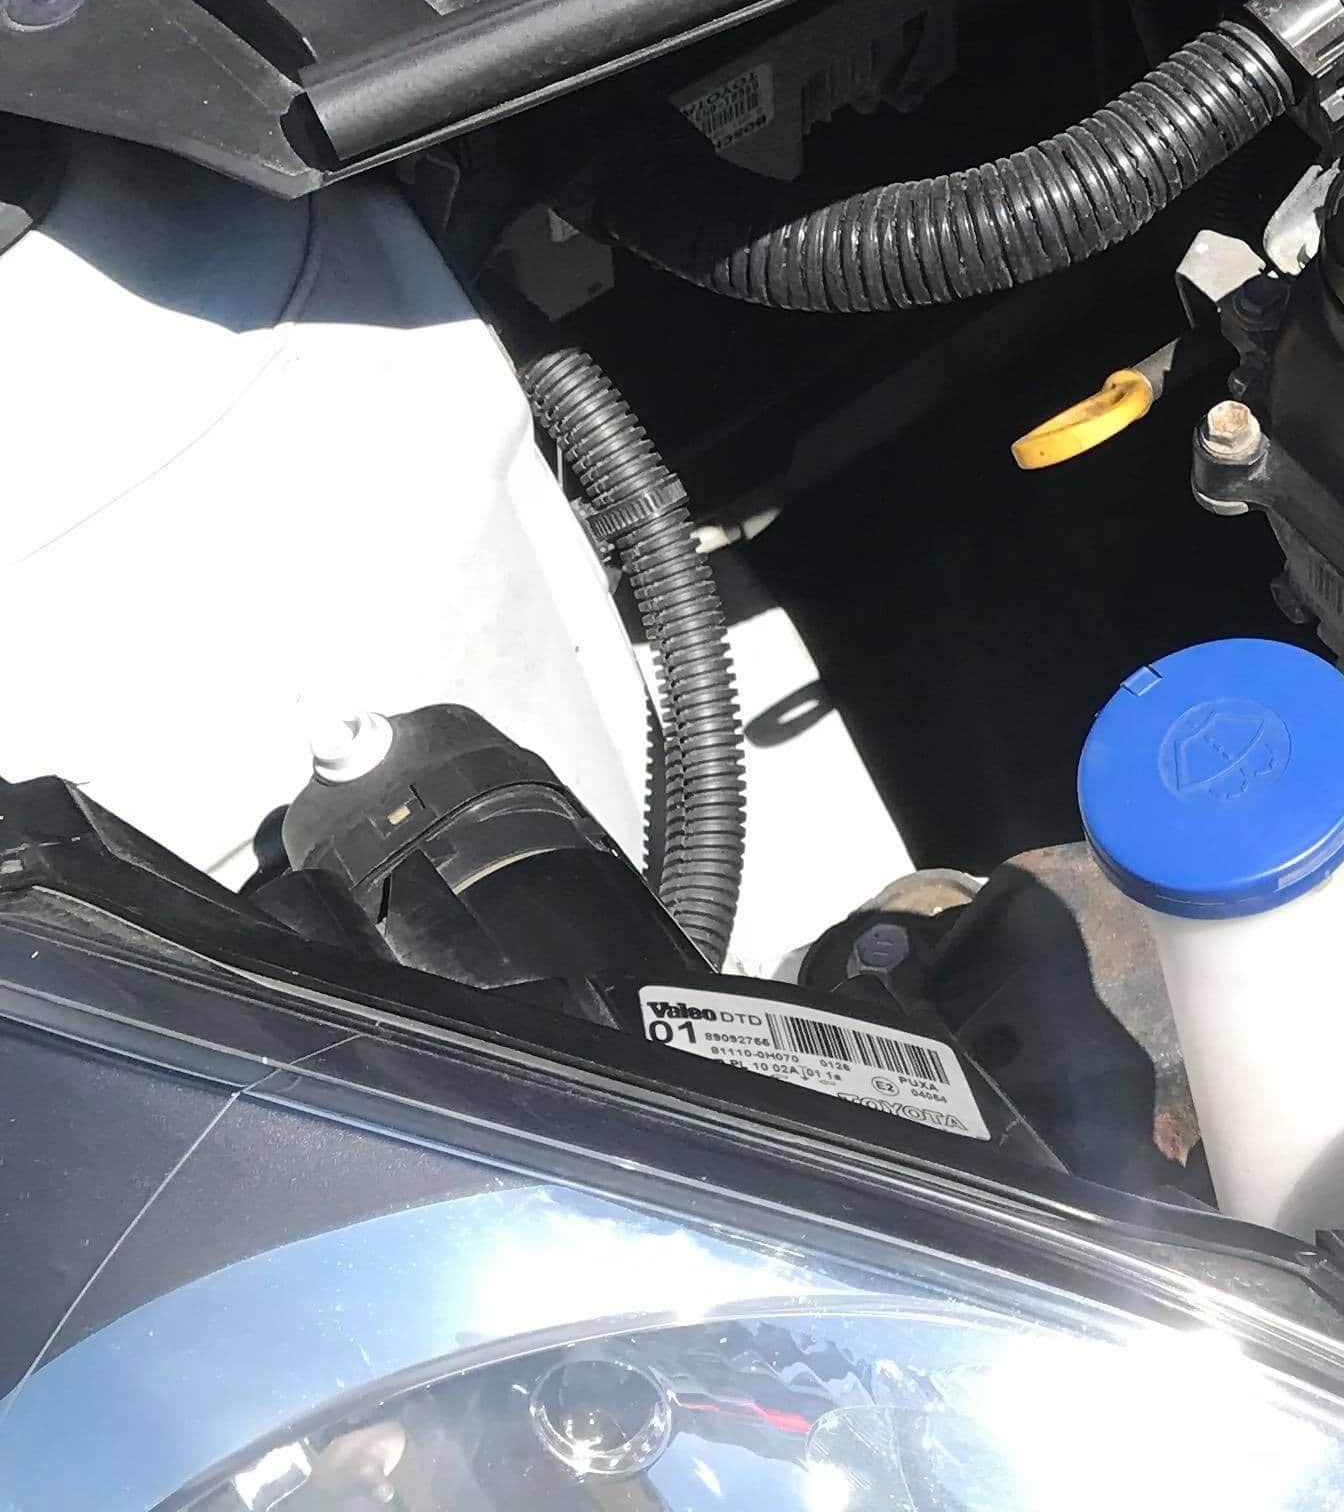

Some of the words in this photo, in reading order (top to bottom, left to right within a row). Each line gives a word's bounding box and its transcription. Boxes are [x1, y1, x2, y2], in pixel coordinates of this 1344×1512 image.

[646, 1001, 717, 1021] Valeo
[720, 1011, 762, 1026] DTD
[648, 1020, 697, 1045] 01
[898, 1076, 939, 1092] PUXA
